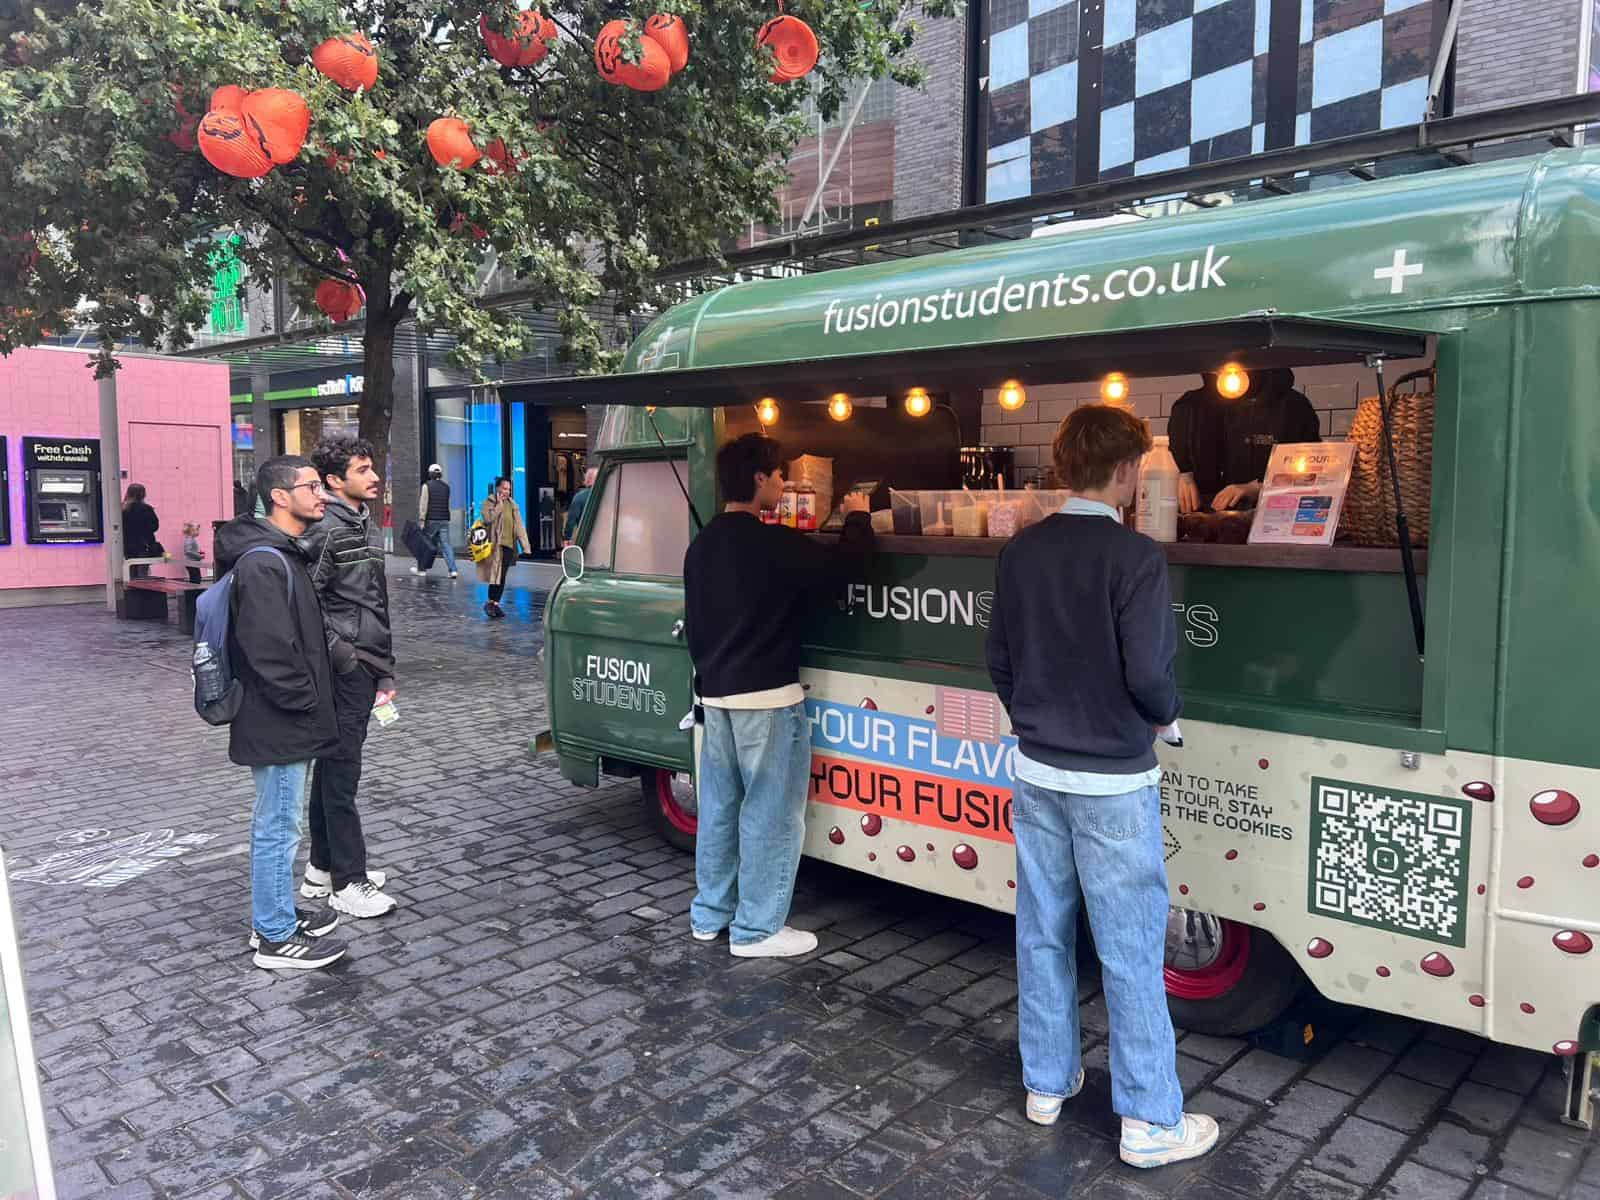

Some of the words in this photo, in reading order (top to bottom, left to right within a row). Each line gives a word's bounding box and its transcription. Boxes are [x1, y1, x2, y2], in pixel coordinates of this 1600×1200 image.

[823, 245, 1231, 335] fusionstudents.co.uk
[34, 443, 61, 455] Free
[63, 444, 92, 455] Cash
[586, 654, 651, 686] FUSION
[572, 677, 667, 716] STUDENTS
[808, 706, 895, 757] YOUR
[810, 762, 902, 811] YOUR
[1160, 770, 1182, 787] AN
[1187, 774, 1210, 791] TO
[1215, 779, 1259, 801] TAKE
[1174, 788, 1224, 812] TOUR,
[1228, 799, 1273, 820] STAY
[1175, 806, 1209, 825] THE
[1213, 813, 1293, 841] COOKIES
